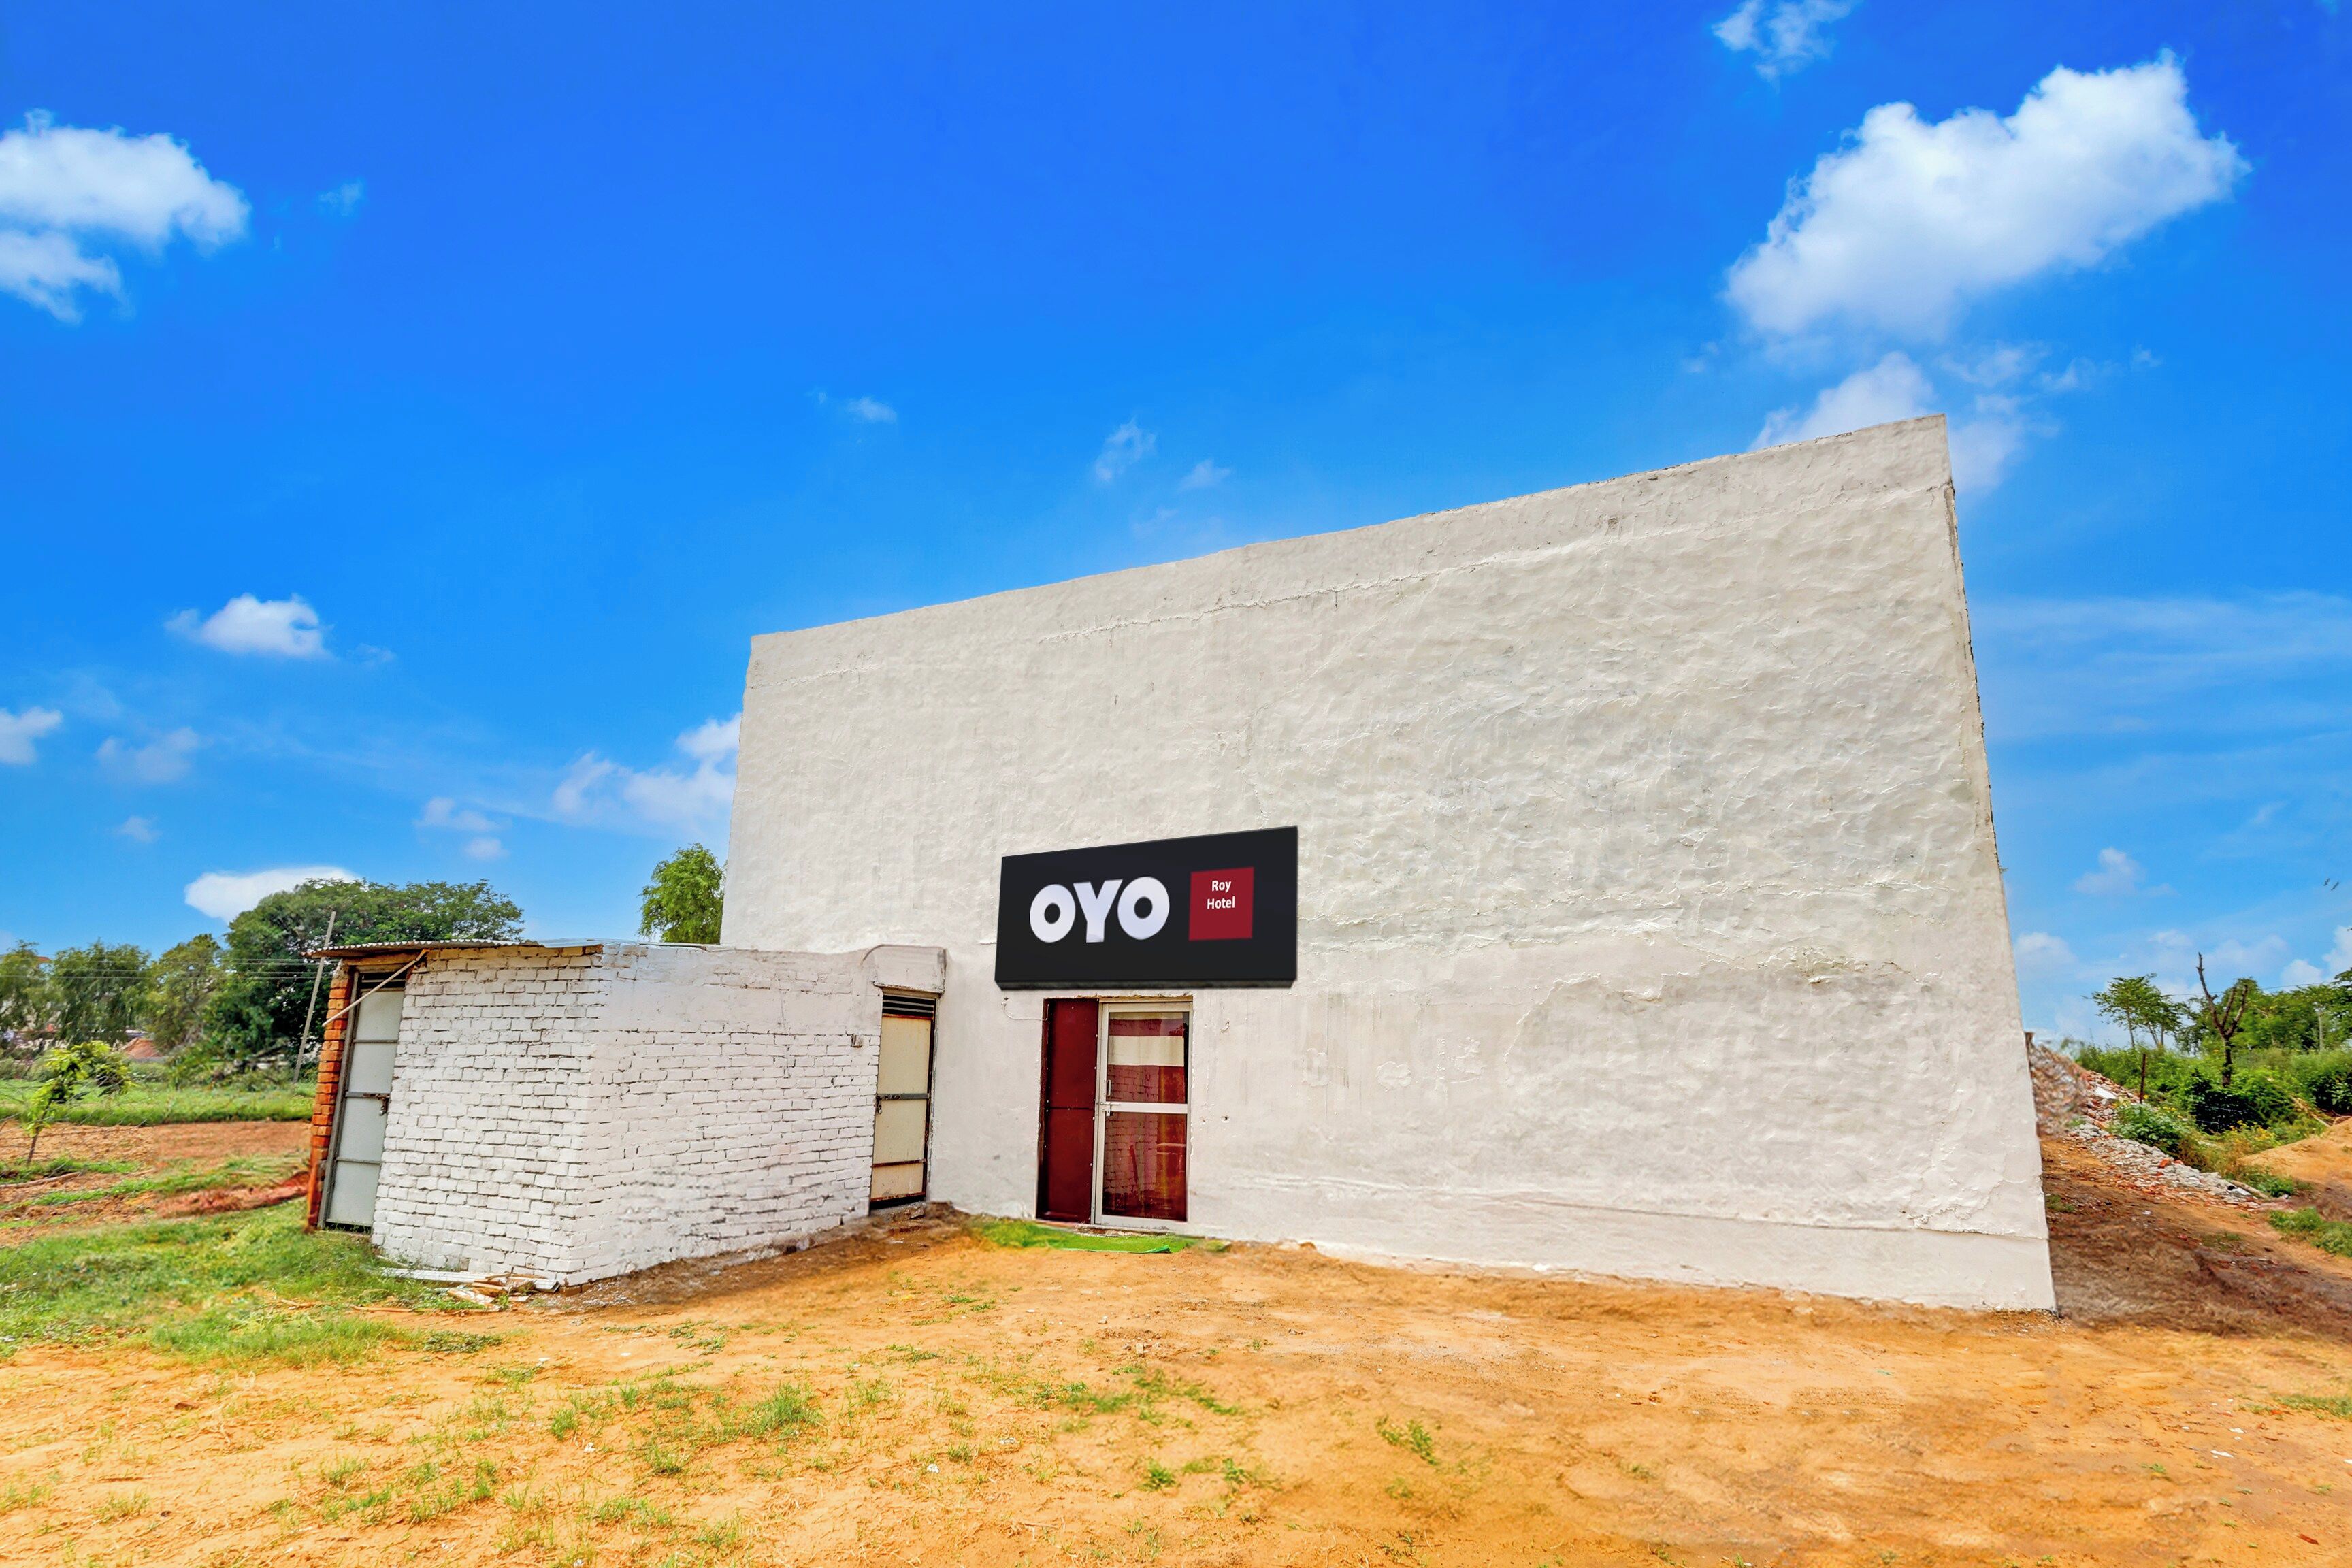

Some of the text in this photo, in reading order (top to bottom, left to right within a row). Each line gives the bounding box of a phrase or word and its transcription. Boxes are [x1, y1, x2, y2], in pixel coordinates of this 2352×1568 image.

[1211, 880, 1232, 893] Roy
[1030, 876, 1170, 943] OYO
[1207, 896, 1235, 910] Hotel
